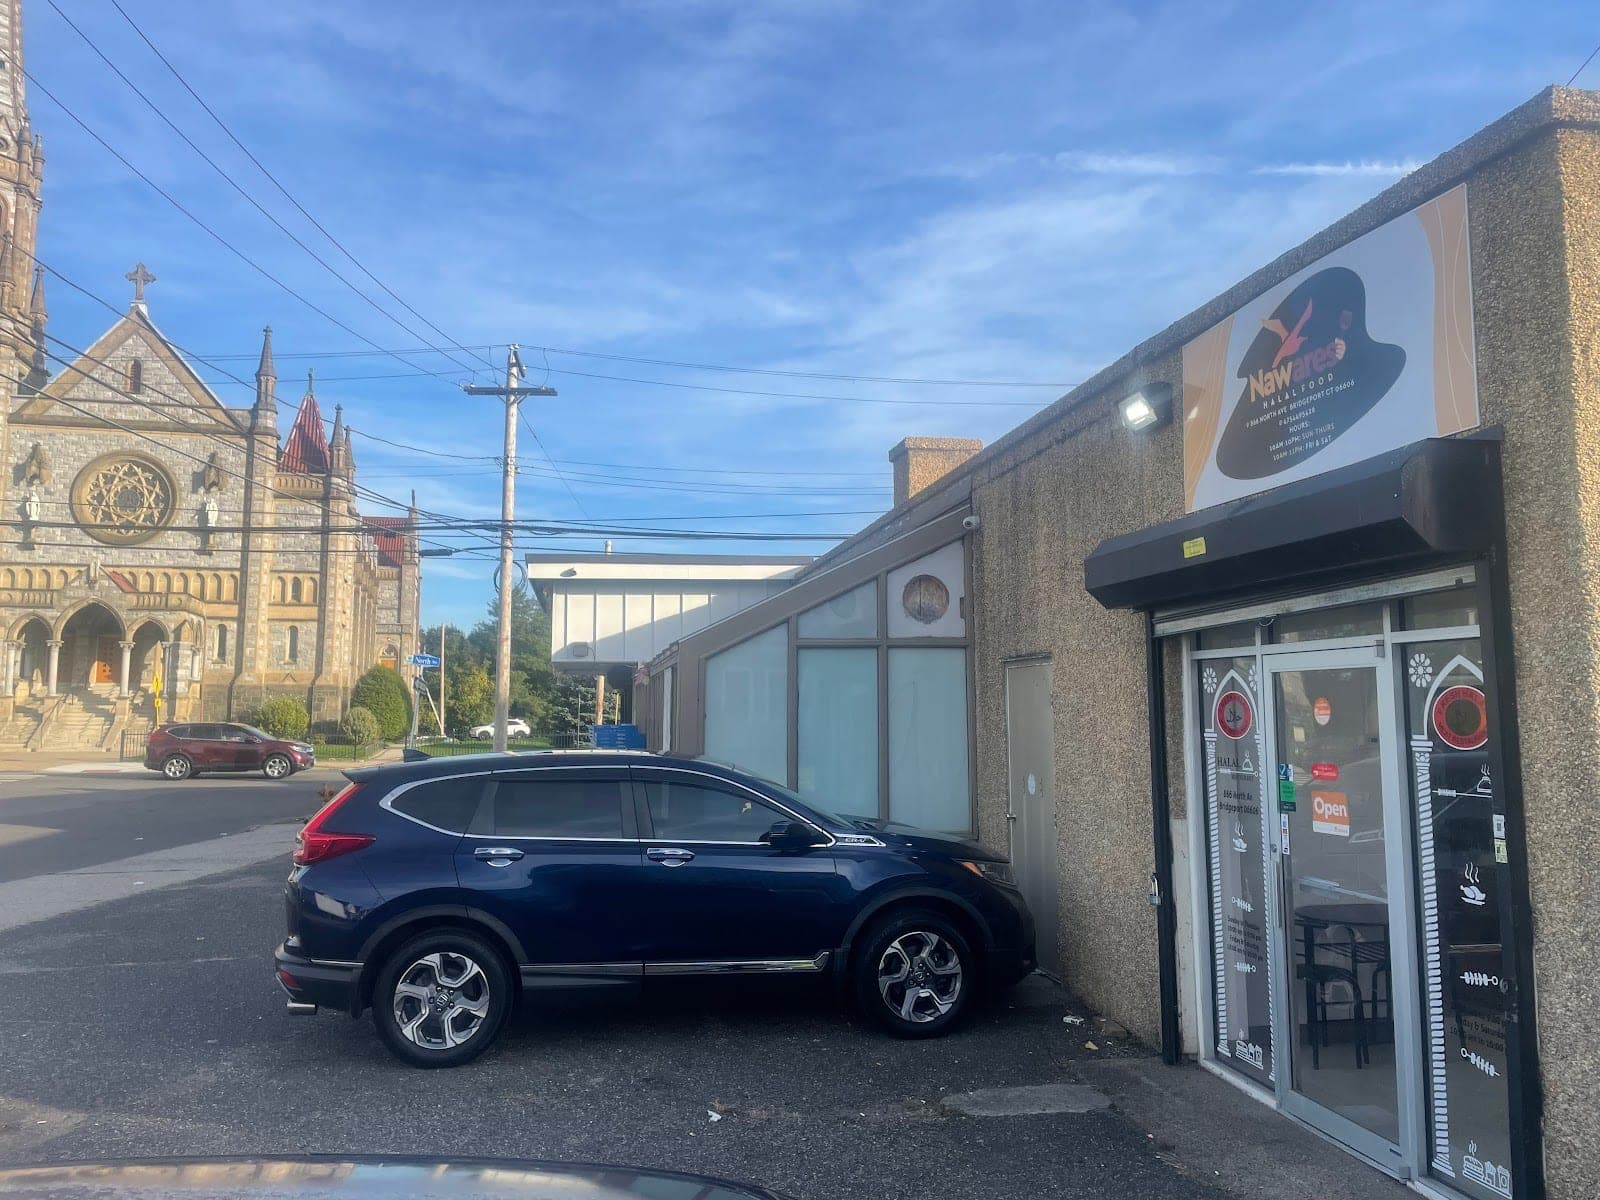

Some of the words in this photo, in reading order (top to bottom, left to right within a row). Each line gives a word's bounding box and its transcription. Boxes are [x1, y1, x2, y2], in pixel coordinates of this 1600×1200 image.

[1249, 342, 1337, 403] Nawares
[1259, 410, 1276, 422] NORTH
[1277, 406, 1287, 416] AVE
[1289, 391, 1324, 410] BRIDGEPORT
[1326, 387, 1333, 396] CT
[1263, 388, 1296, 409] HALAL
[1301, 373, 1334, 392] FOOD
[416, 656, 431, 664] North
[1314, 796, 1347, 819] Open
